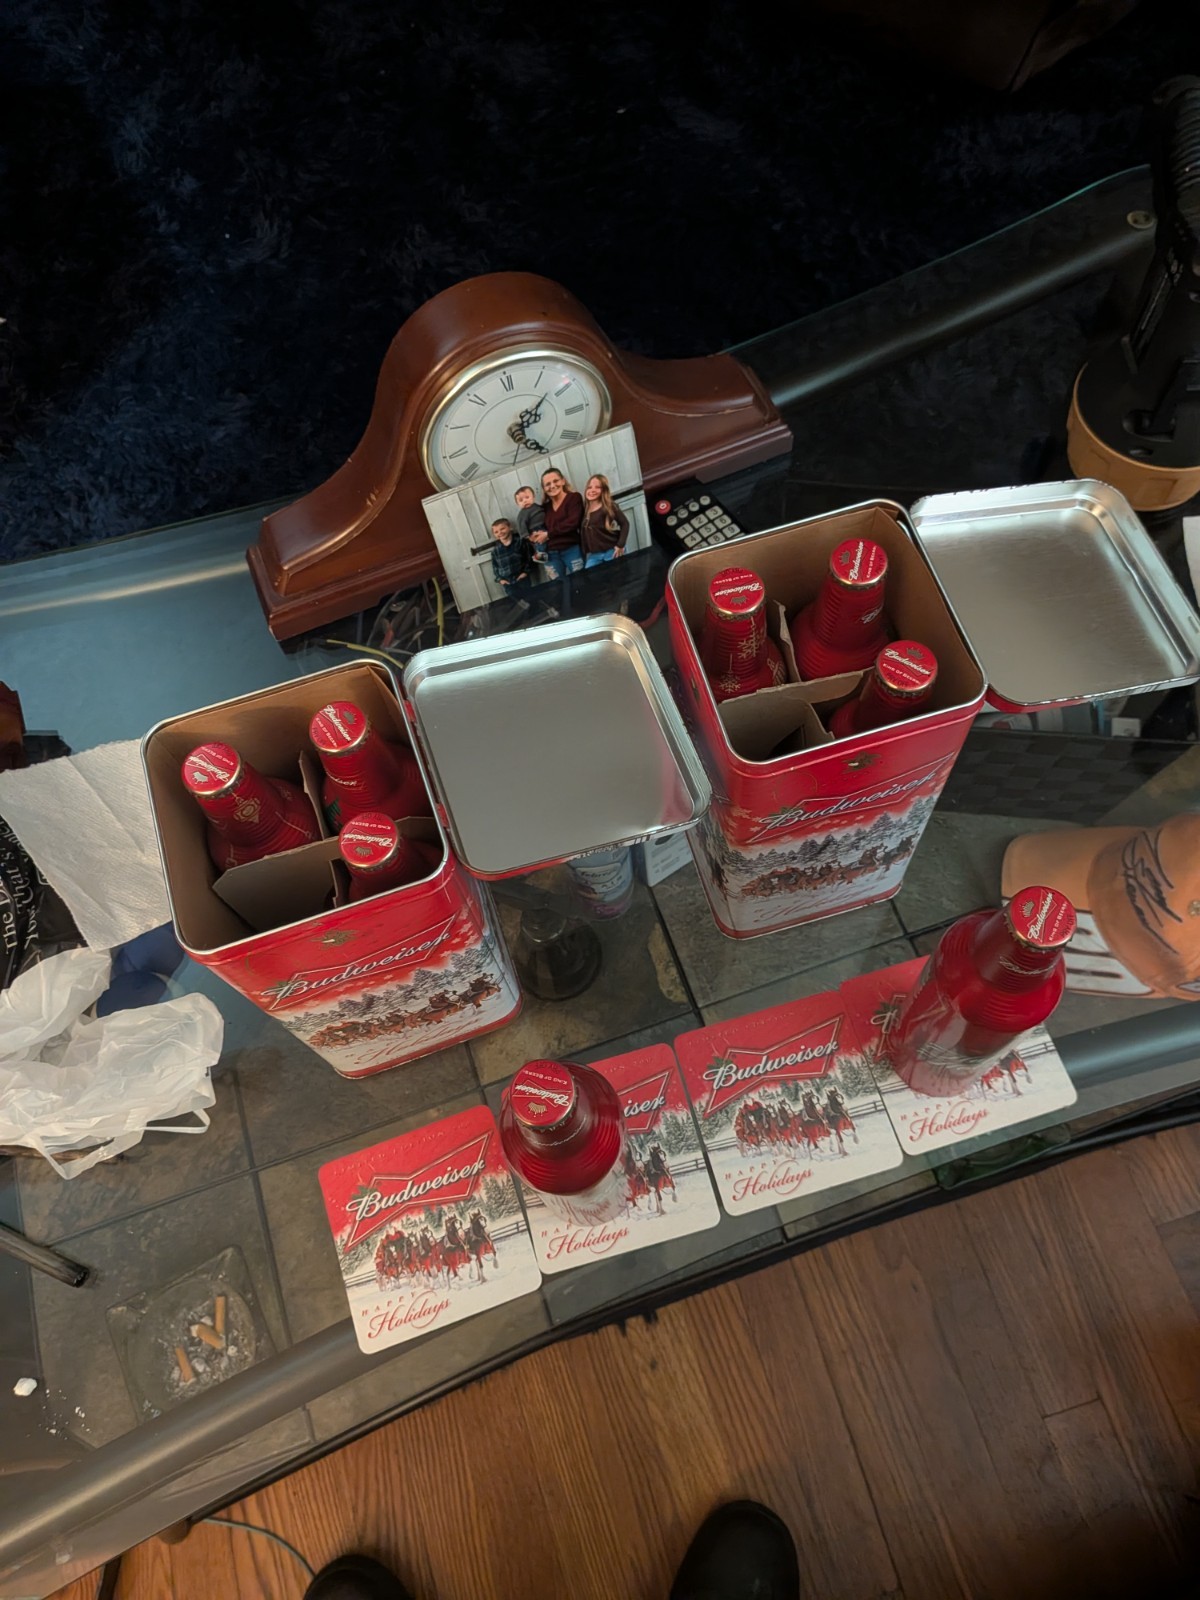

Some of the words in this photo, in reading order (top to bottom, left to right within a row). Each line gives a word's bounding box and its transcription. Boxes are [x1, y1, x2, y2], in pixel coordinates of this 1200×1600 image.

[849, 541, 864, 581] Budweiser
[714, 582, 763, 596] Budweiser
[884, 648, 931, 675] Budweiser
[323, 704, 352, 742] Budweiser
[188, 756, 231, 783] Budweiser
[758, 771, 936, 830] Budweiser
[343, 833, 393, 847] Budweiser
[2, 911, 18, 955] The
[1027, 892, 1053, 940] Budweiser
[260, 933, 451, 999] Budweiser
[703, 1040, 838, 1089] Budweiser
[515, 1084, 570, 1107] Budweiser
[909, 1100, 990, 1142] Holidays
[345, 1160, 485, 1220] Budweiser
[725, 1159, 777, 1181] HAPPY
[732, 1159, 814, 1202] Holidays
[546, 1224, 630, 1260] Holidays
[361, 1291, 416, 1317] HAPPY
[368, 1289, 451, 1339] Holidays
